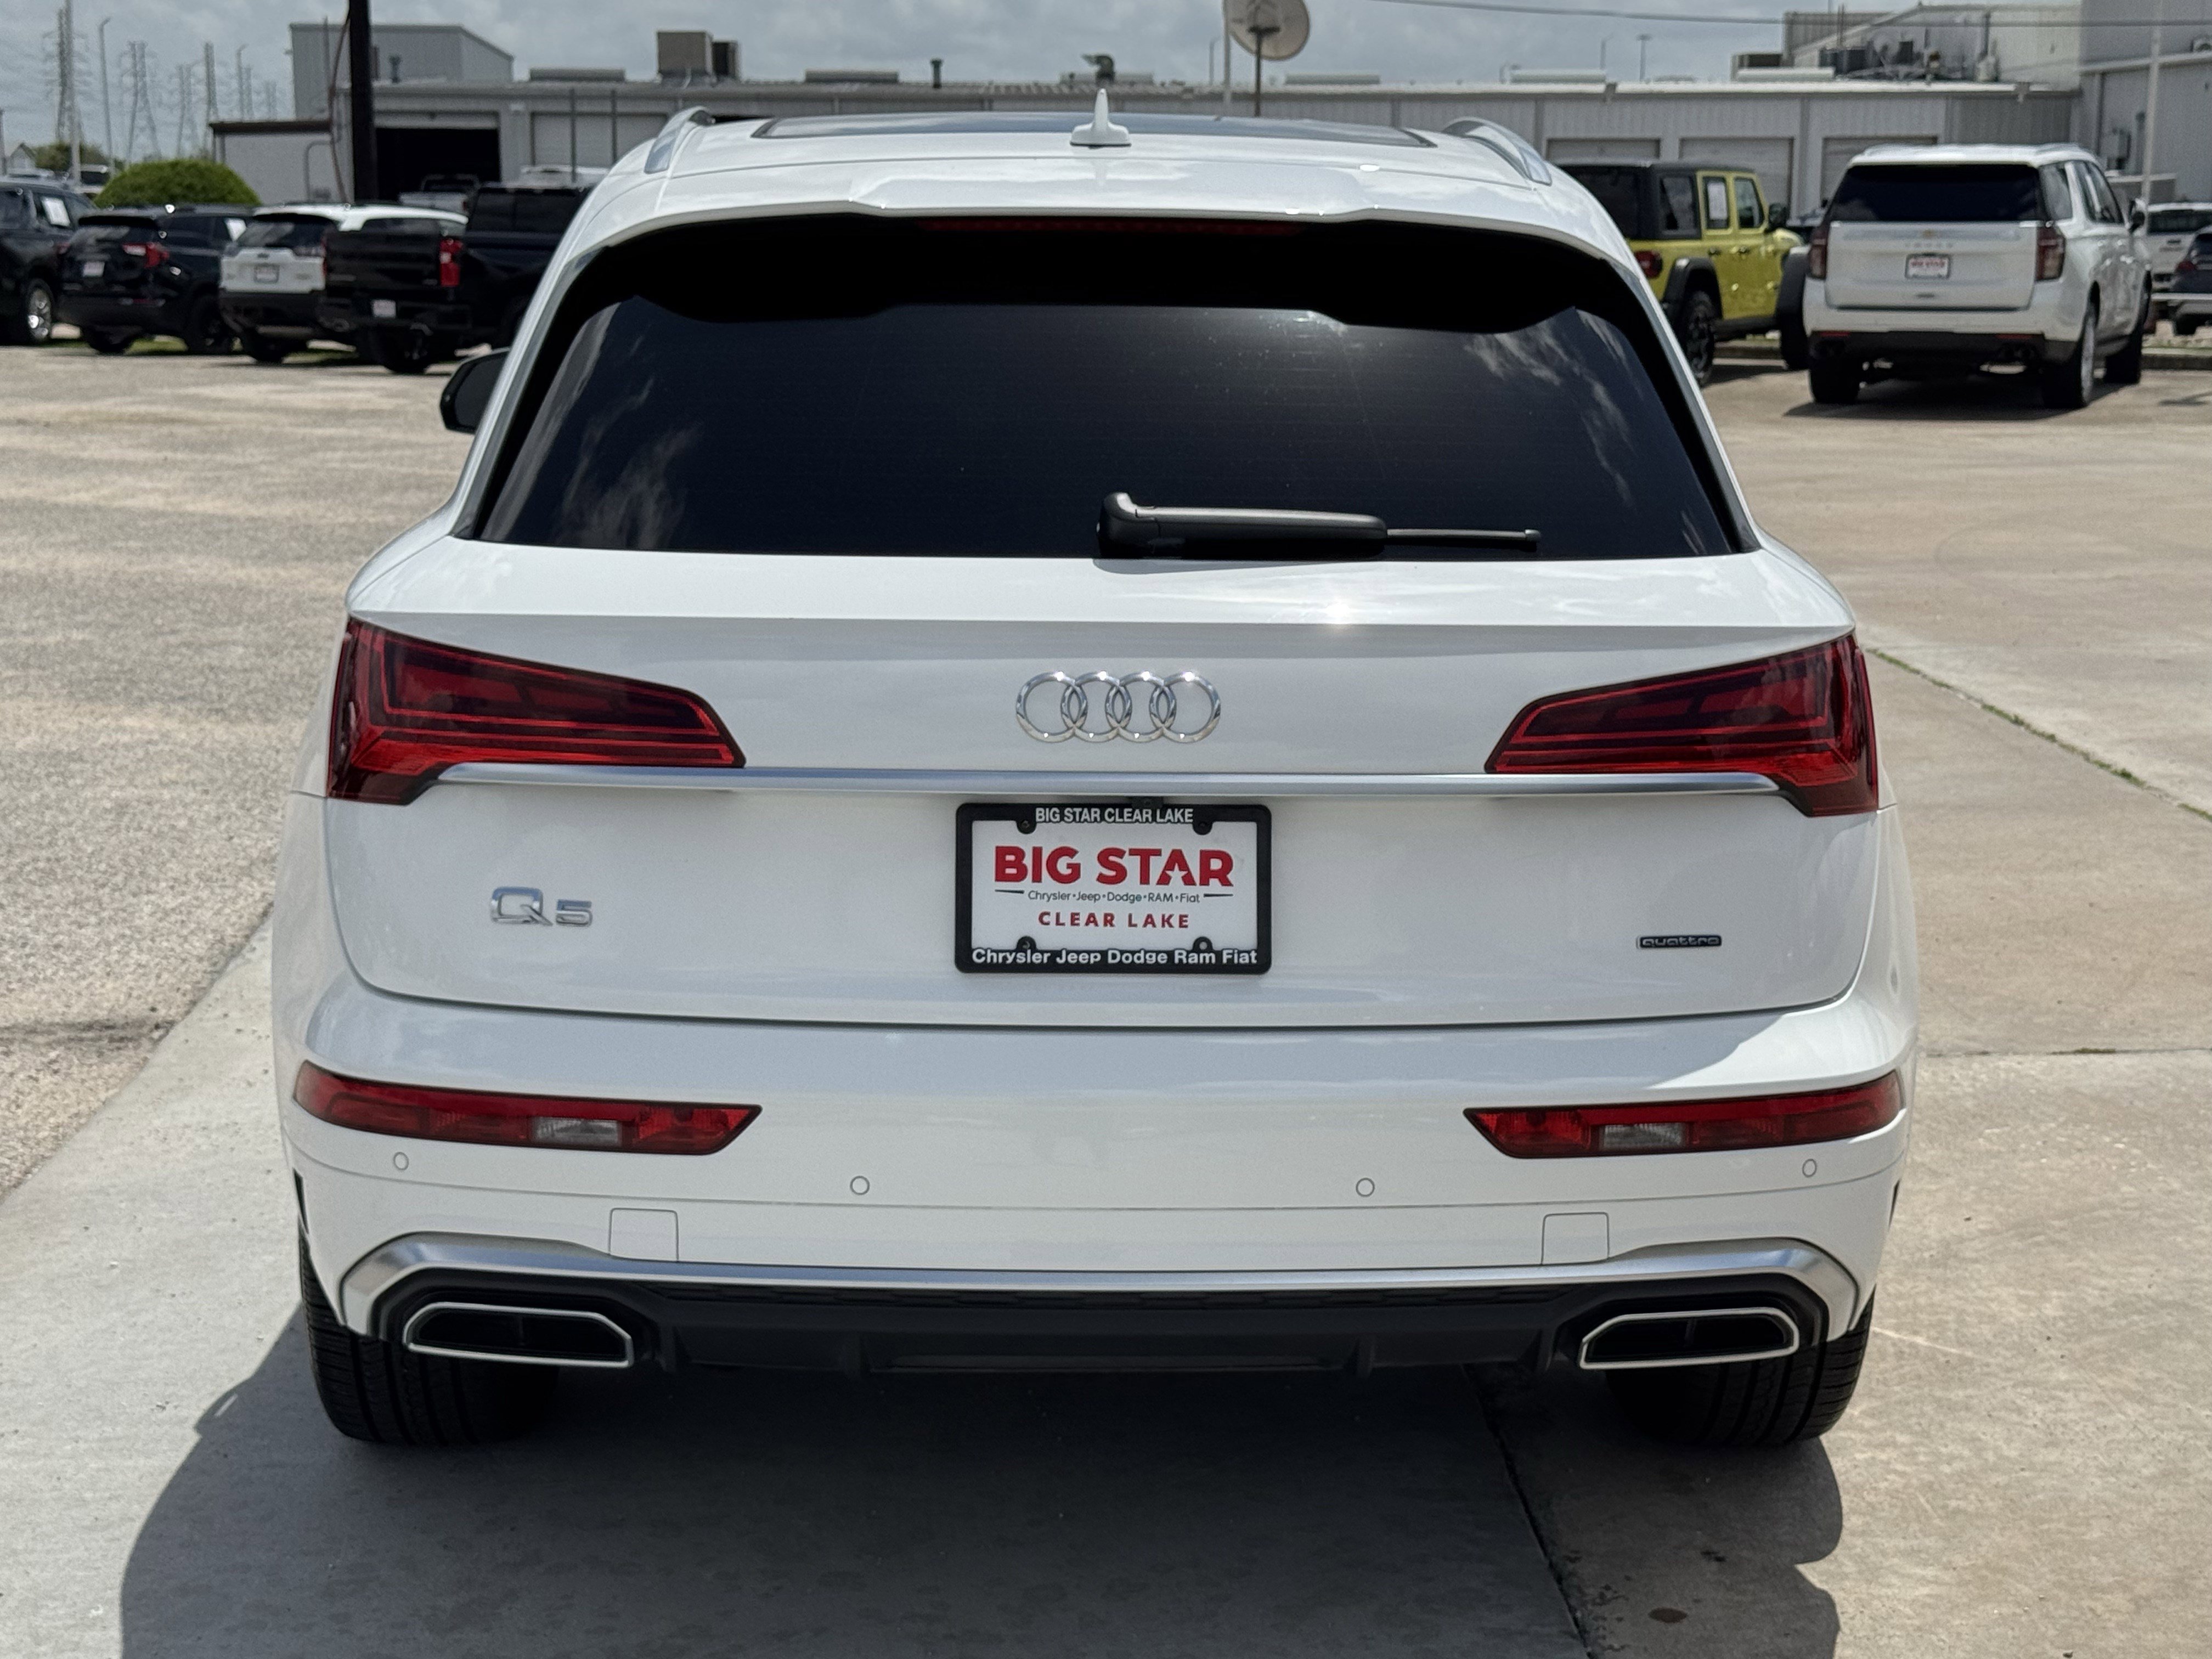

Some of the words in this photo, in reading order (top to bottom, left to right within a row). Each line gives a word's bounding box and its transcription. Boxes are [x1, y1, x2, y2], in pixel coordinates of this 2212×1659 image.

[1035, 808, 1060, 822] BIG
[1064, 808, 1101, 822] STAR
[1104, 808, 1152, 822] CLEAR
[1156, 808, 1194, 822] LAKE
[995, 845, 1081, 884] BIG
[1096, 847, 1234, 887] STAR
[1028, 890, 1071, 902] Chrysler
[1077, 892, 1101, 903] Jeep
[1107, 891, 1142, 904] Dodge
[1148, 893, 1173, 902] RAM
[1180, 893, 1200, 903] Fiat
[491, 886, 593, 927] Q5
[1038, 911, 1115, 928] CLEAR
[1127, 913, 1189, 928] LAKE
[1642, 936, 1719, 947] quattro
[972, 948, 1051, 964] Chrysler
[1056, 949, 1102, 964] Jeep
[1107, 950, 1169, 964] Dodge
[1174, 950, 1216, 964] Ram
[1222, 950, 1257, 964] Fiat
